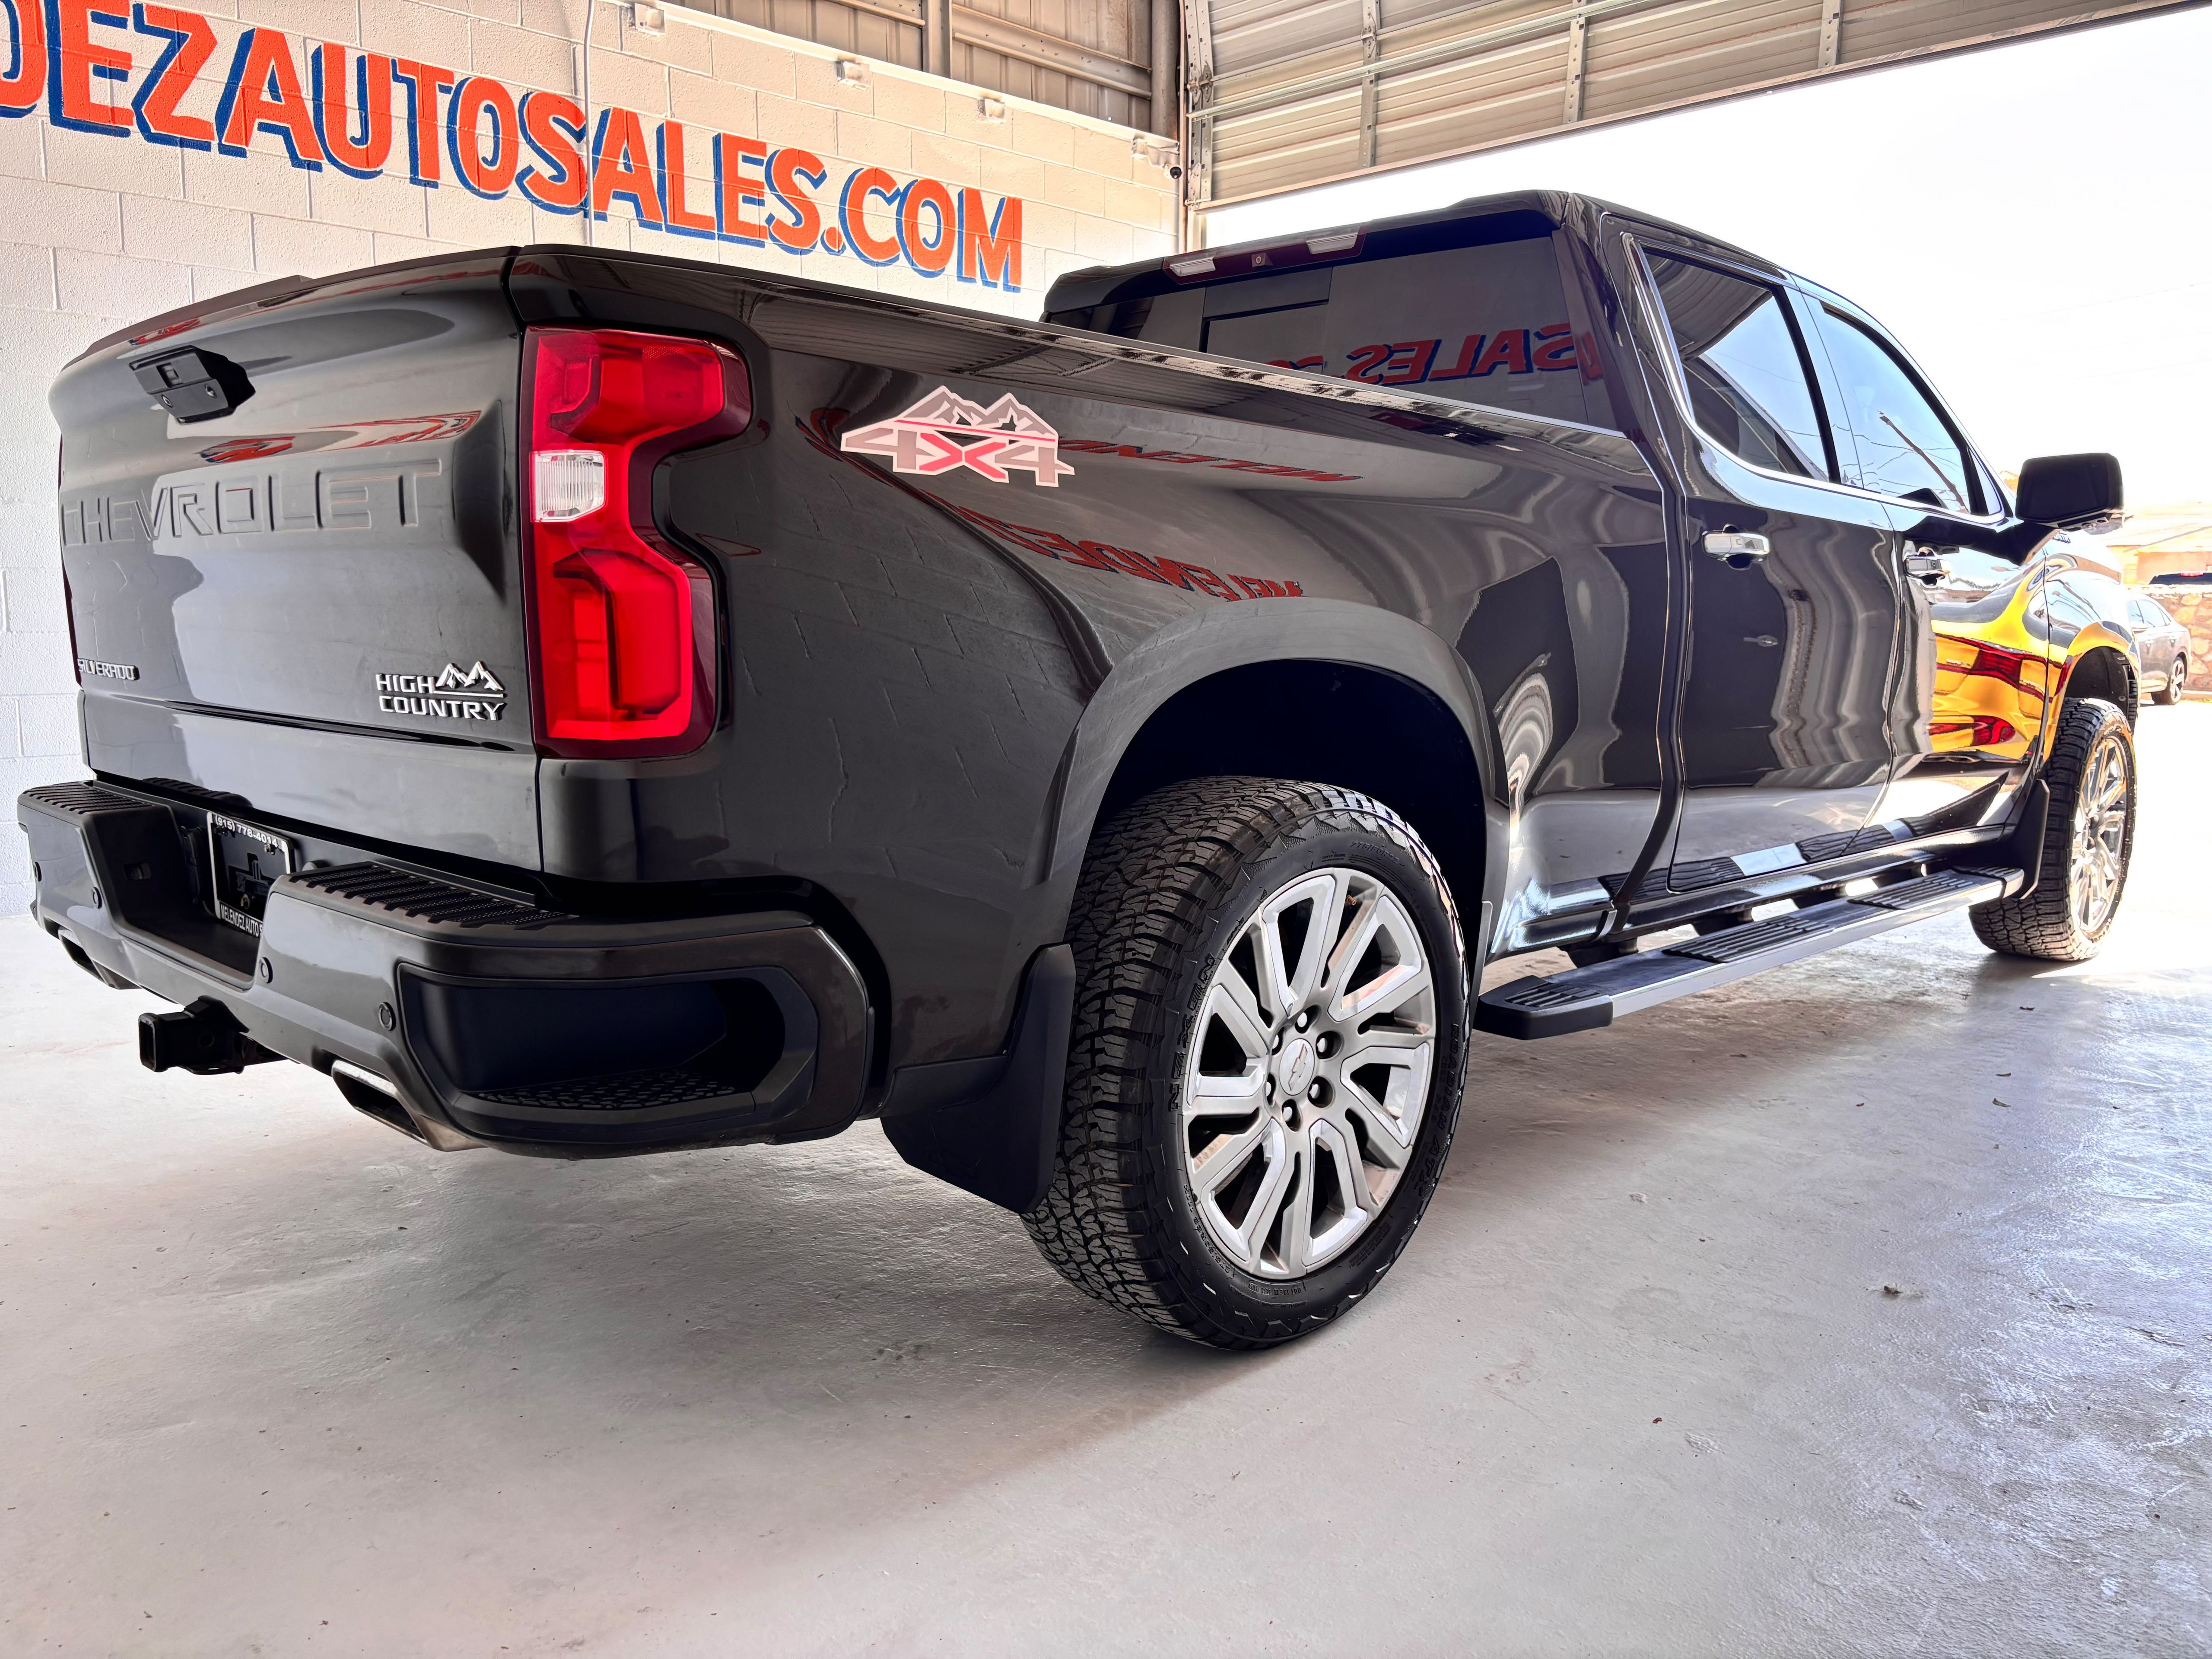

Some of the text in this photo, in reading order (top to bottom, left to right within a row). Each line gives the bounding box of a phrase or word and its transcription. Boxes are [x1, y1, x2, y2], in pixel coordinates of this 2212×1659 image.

[61, 458, 442, 547] CHEVROLET
[77, 659, 135, 680] SILVERADO
[375, 674, 435, 694] HIGH
[379, 695, 505, 721] COUNTRY
[215, 814, 278, 848] (915) 778-4014
[221, 903, 245, 931] MELENDEZ
[245, 918, 259, 937] AUTO
[1168, 953, 1216, 1112] NEXEN
[1437, 1023, 1460, 1131] ROADIAN
